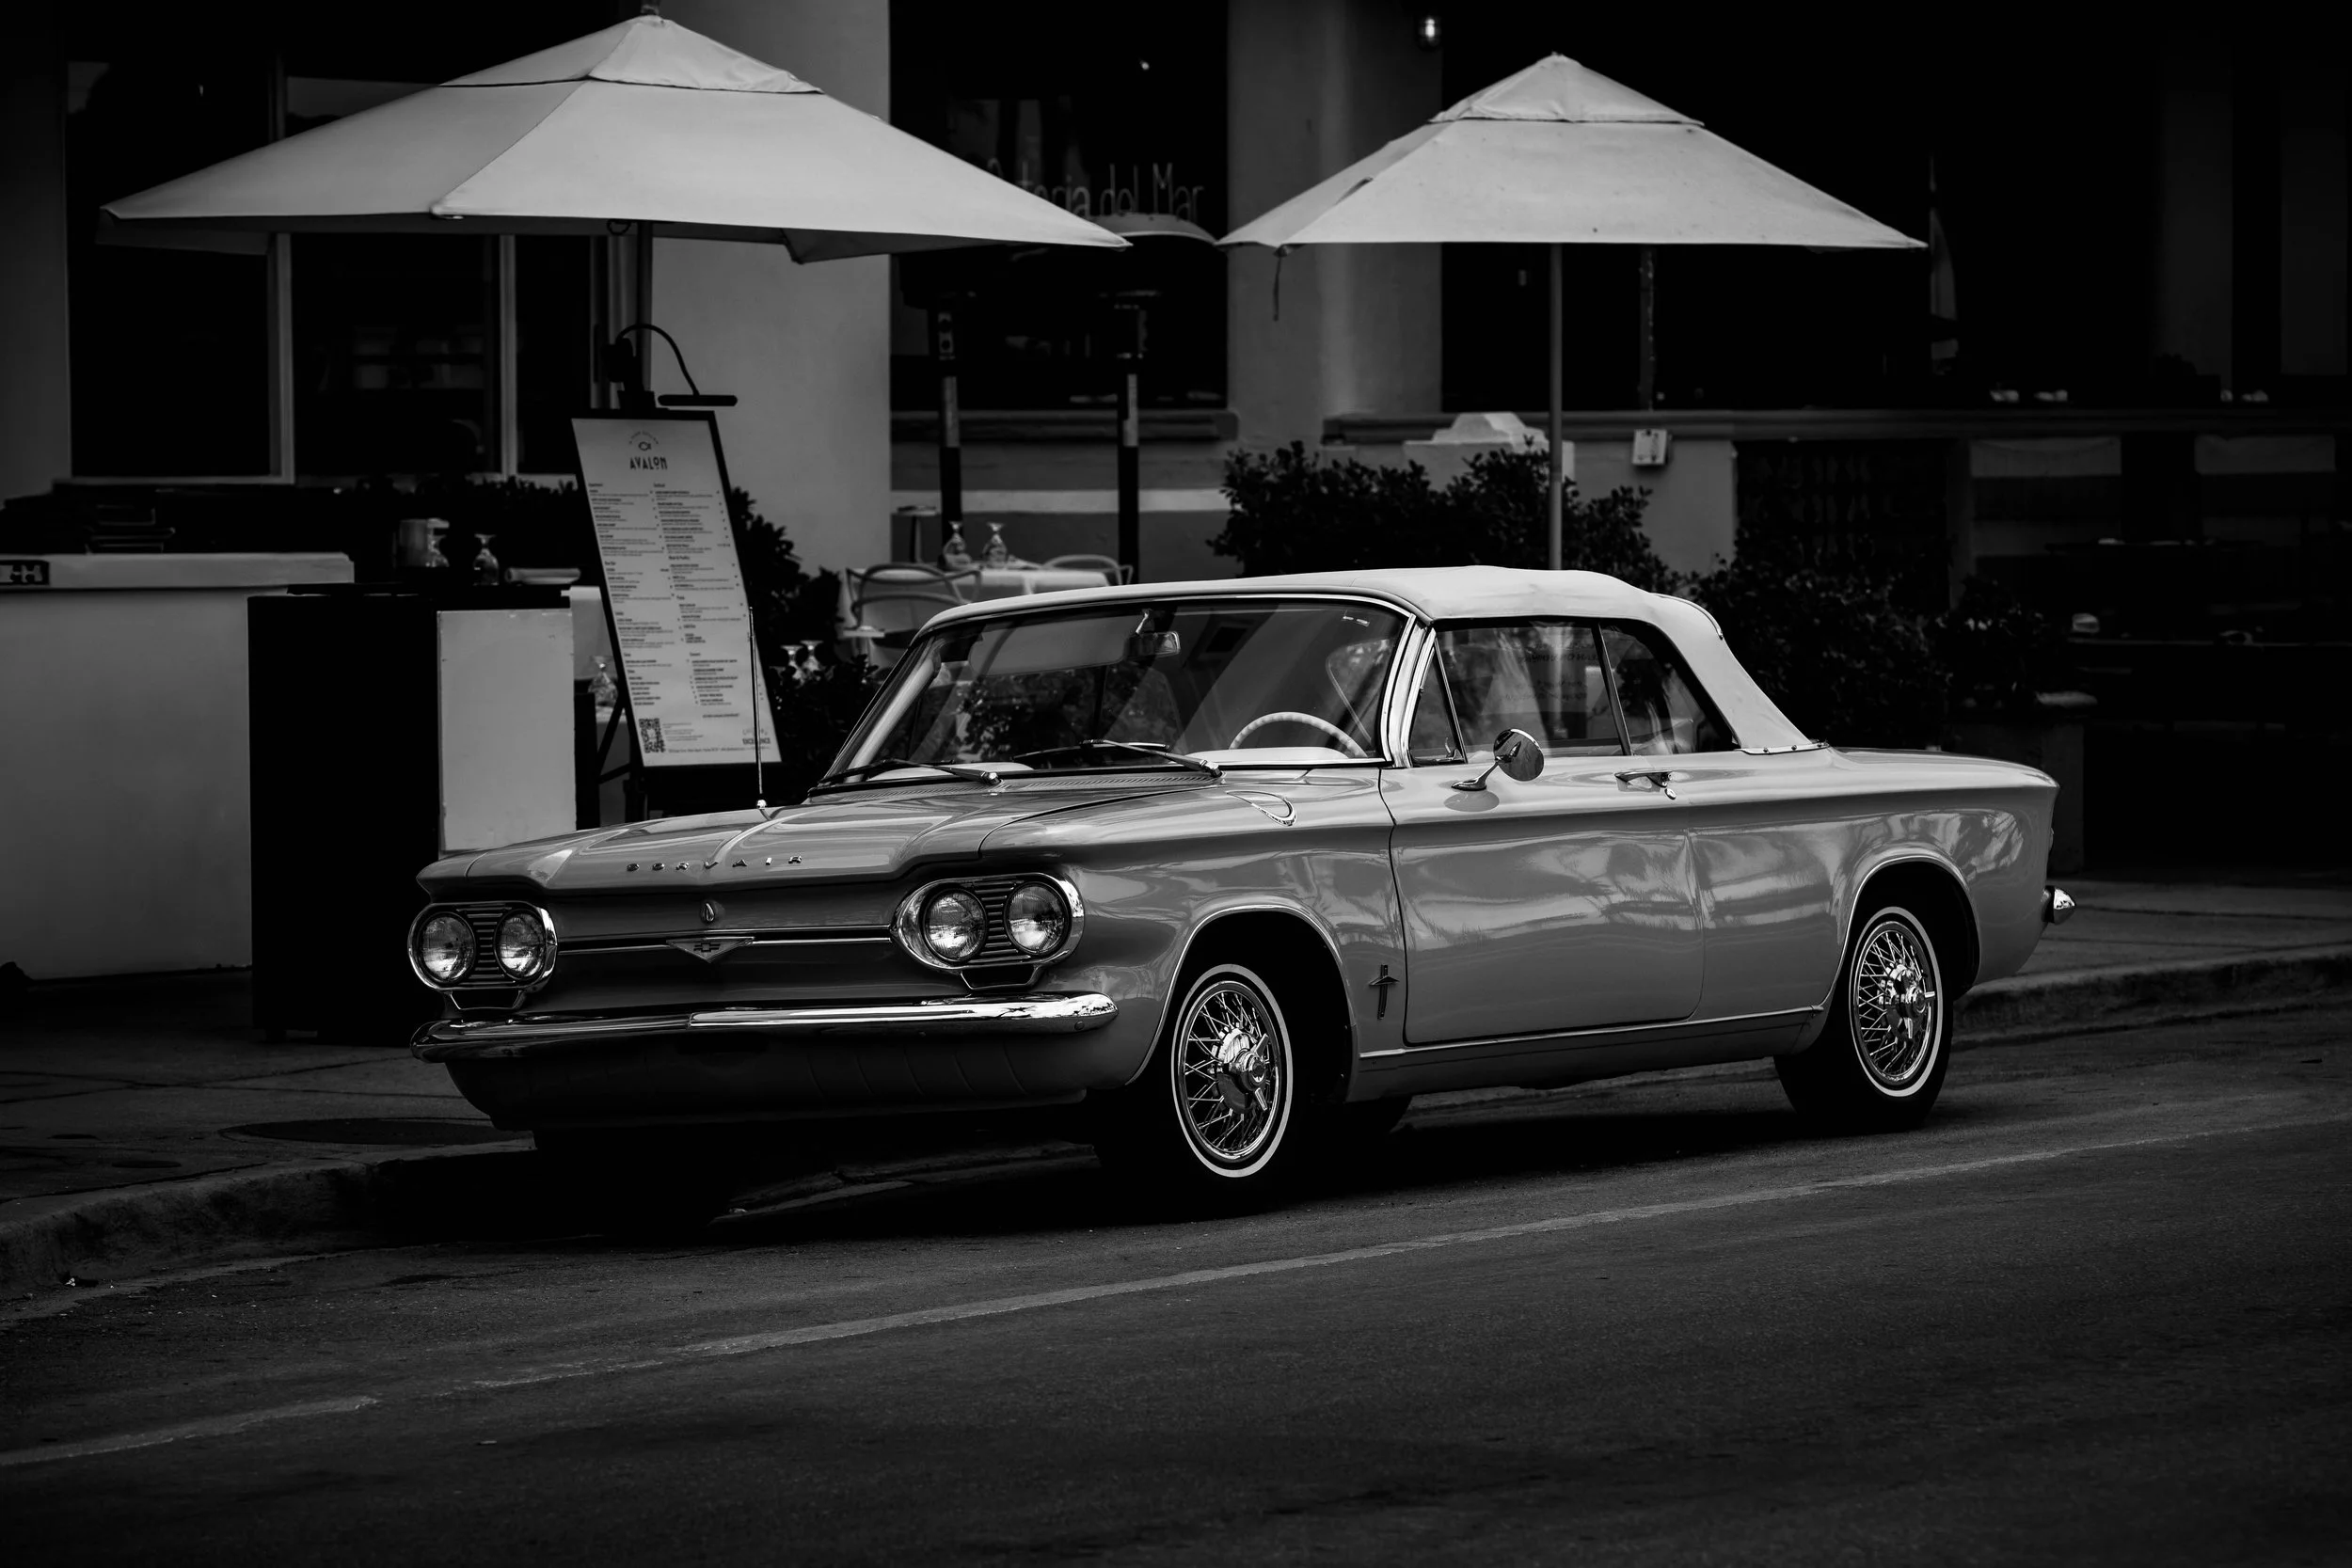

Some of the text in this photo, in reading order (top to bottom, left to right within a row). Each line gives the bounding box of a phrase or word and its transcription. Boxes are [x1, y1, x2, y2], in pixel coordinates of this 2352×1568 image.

[1099, 163, 1139, 215] del
[1152, 162, 1205, 223] Mar
[629, 456, 668, 470] AVALON
